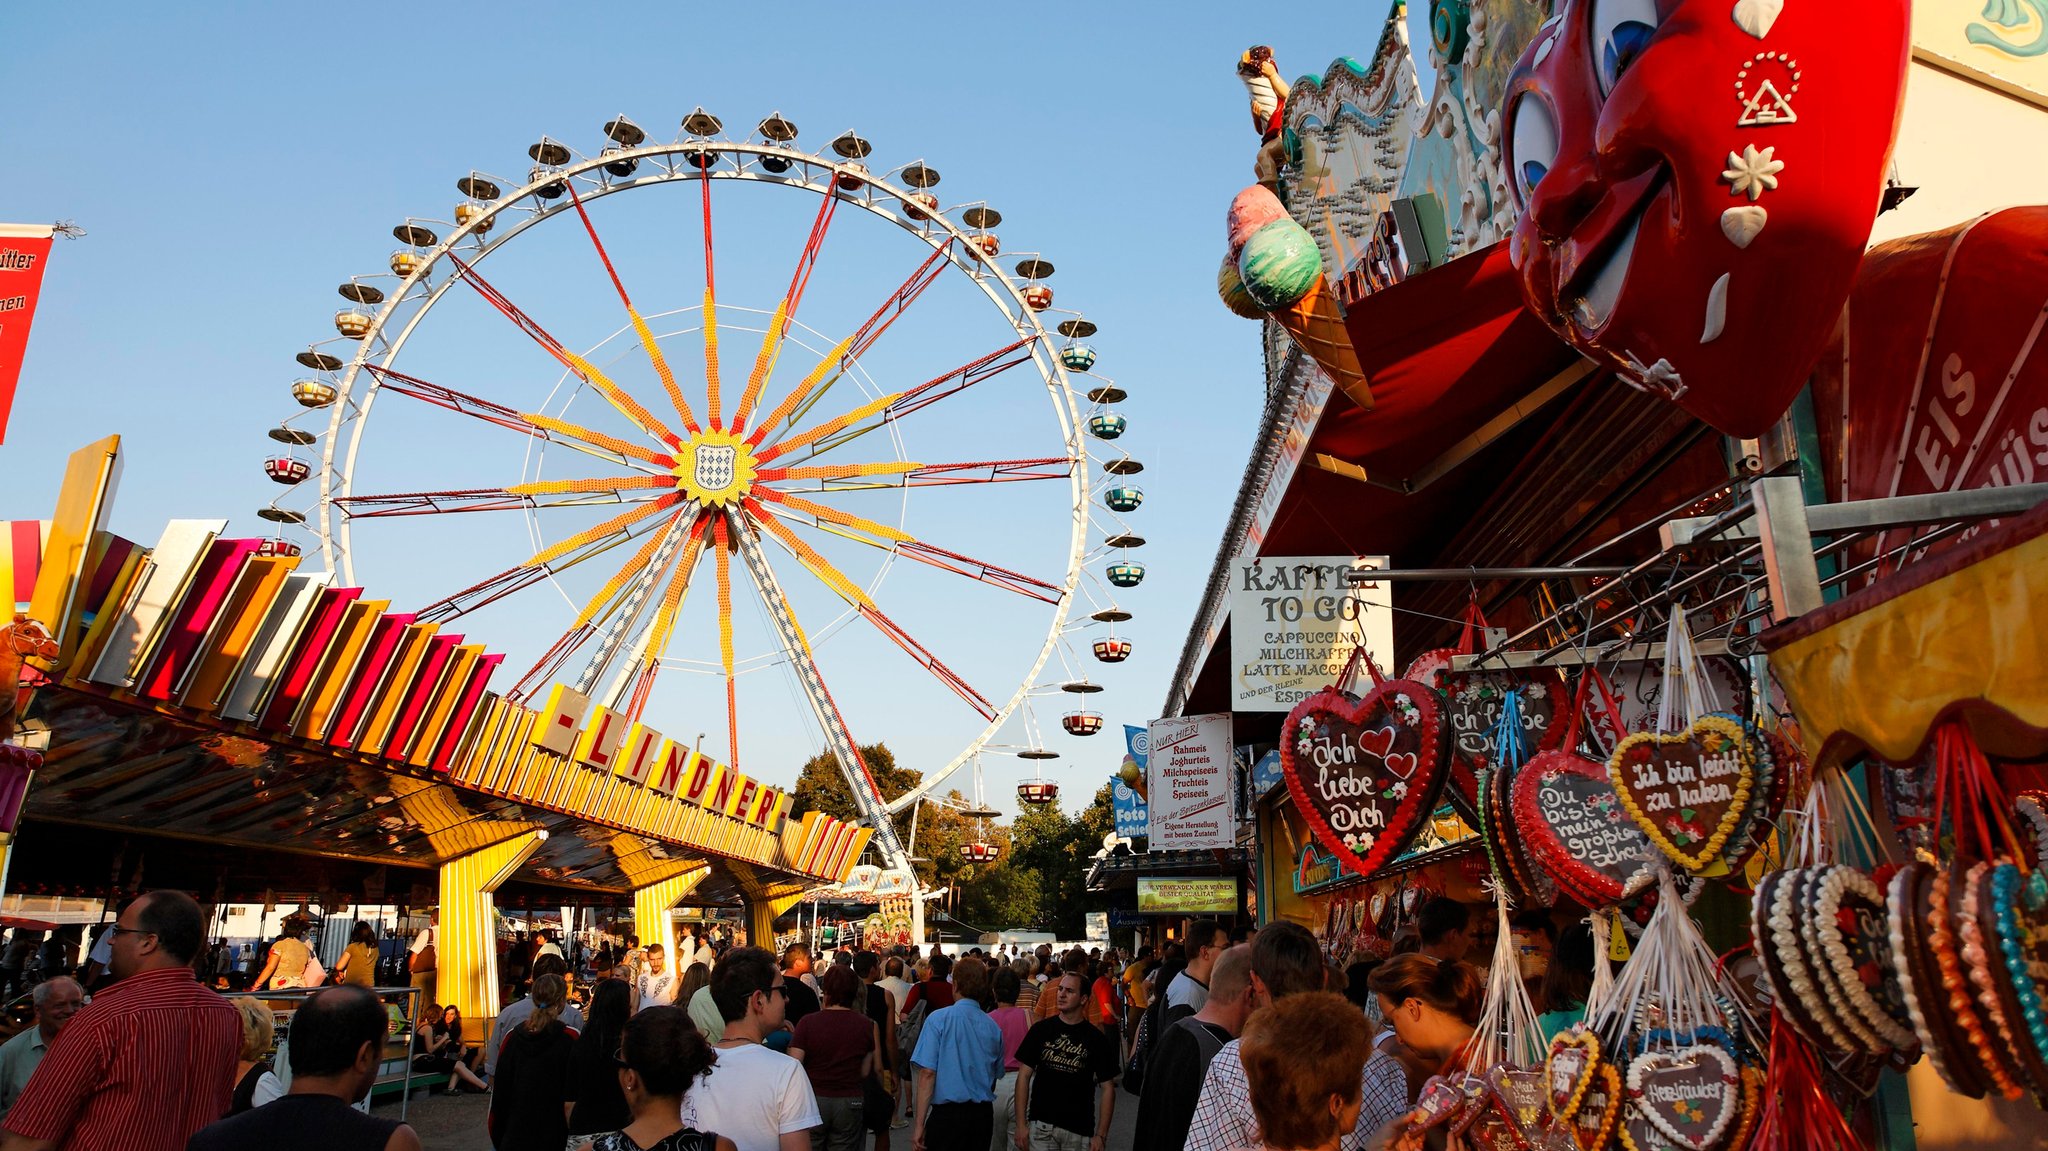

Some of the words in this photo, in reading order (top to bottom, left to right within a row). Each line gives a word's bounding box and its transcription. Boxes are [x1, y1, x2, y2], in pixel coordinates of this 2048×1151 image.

[1915, 353, 1976, 490] EIS
[1242, 564, 1380, 592] KAFFEE
[1261, 596, 1304, 622] TO
[1313, 596, 1361, 622] GO
[1264, 632, 1361, 645] CAPPUCCINO
[1259, 648, 1364, 660] MILCHKAFFE
[1244, 664, 1291, 676] LATTE
[1240, 691, 1256, 700] UND
[1258, 685, 1274, 695] DER
[1275, 677, 1304, 692] KLEINE
[1453, 704, 1479, 731] ch
[1156, 733, 1175, 748] NUR
[1175, 724, 1200, 742] HIER!
[1173, 745, 1207, 755] Rahmeis
[1313, 733, 1357, 768] Ich
[588, 713, 775, 826] LINDNER
[1163, 766, 1218, 778] Milchspeiseeis
[1170, 756, 1211, 767] Joghurteis
[1632, 763, 1663, 790] Ich
[1665, 760, 1697, 783] bin
[1699, 750, 1742, 780] leicht
[1172, 779, 1209, 788] Fruchteis
[1314, 766, 1377, 801] liebe
[1172, 790, 1209, 801] Speiseeis
[1539, 787, 1579, 808] Du
[1646, 791, 1675, 812] zu
[1677, 780, 1734, 807] haben
[1116, 808, 1146, 822] Foto
[1169, 811, 1178, 820] der
[1330, 799, 1386, 832] Dich
[1541, 803, 1596, 824] bist
[1164, 822, 1184, 832] Eigene
[1185, 821, 1219, 830] Herstellung
[1174, 830, 1193, 839] besten
[1194, 829, 1219, 838] Zutaten!
[1555, 818, 1607, 838] mein
